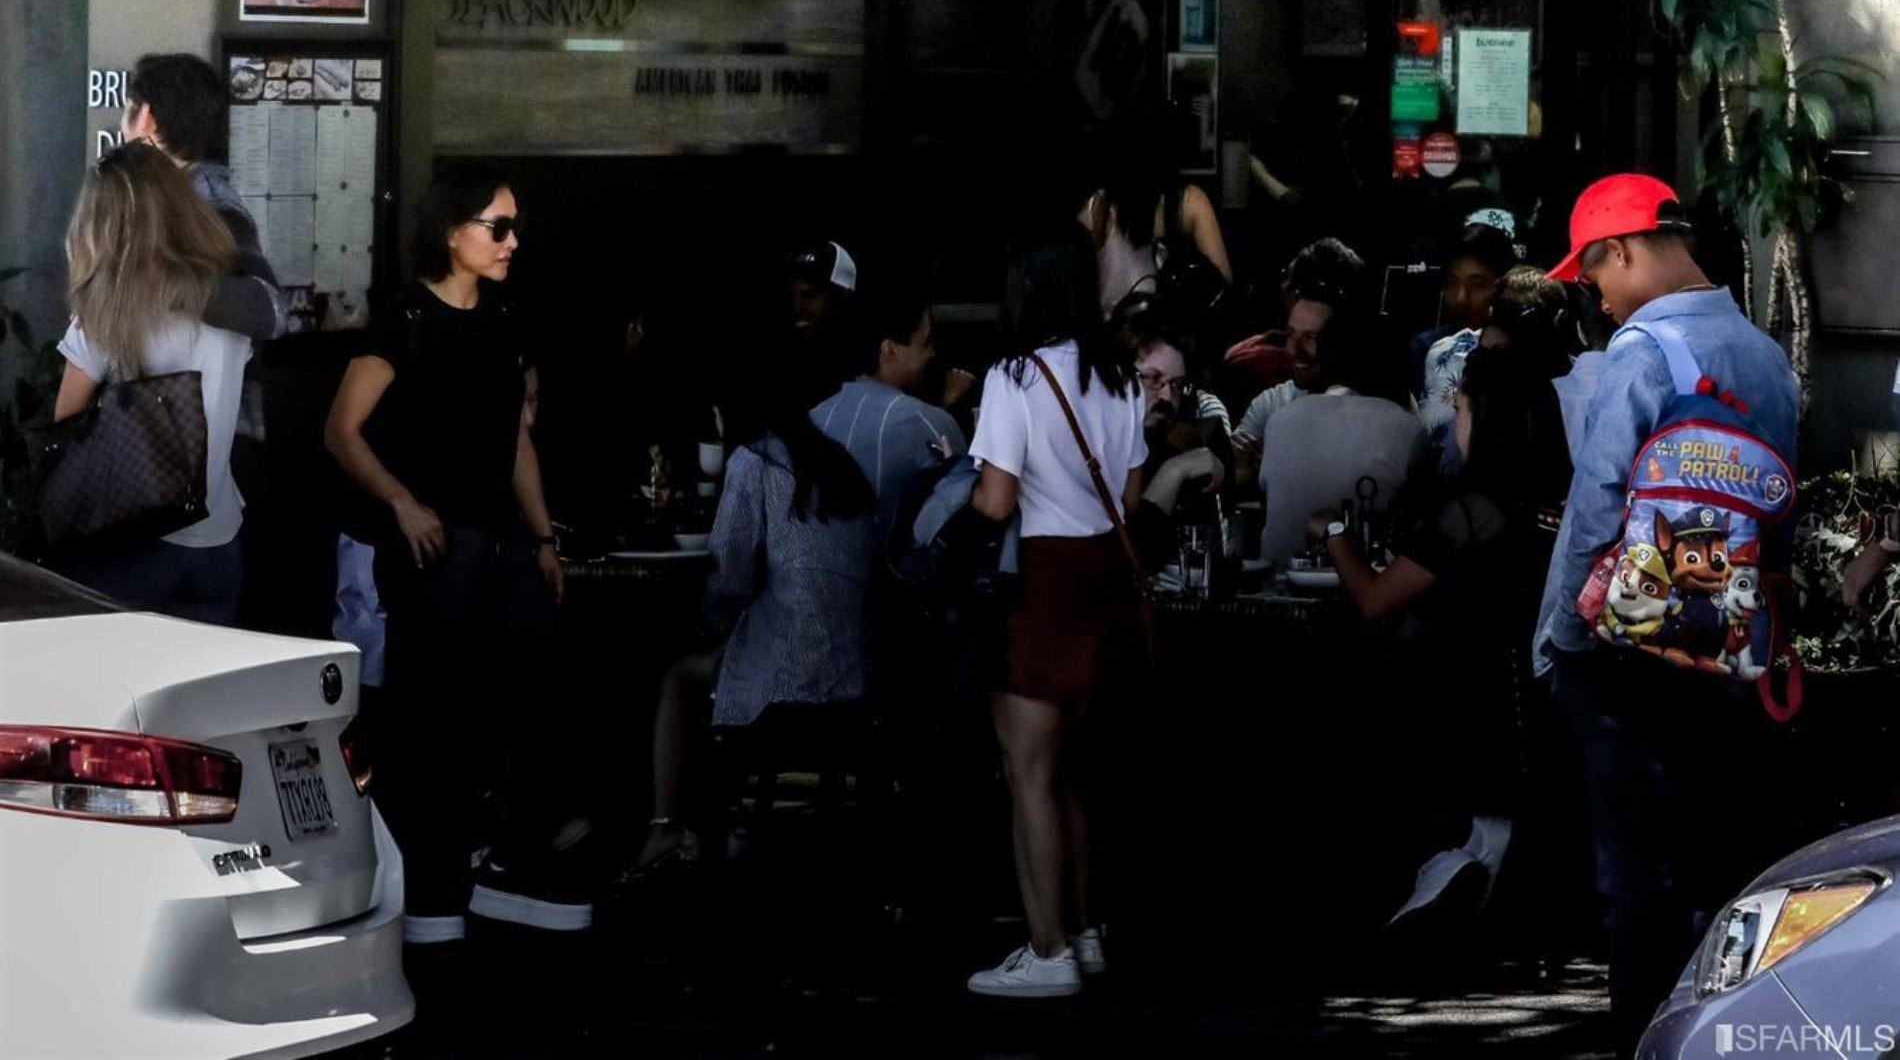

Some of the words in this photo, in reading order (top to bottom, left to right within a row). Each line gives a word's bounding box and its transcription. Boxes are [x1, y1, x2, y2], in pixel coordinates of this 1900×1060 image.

[1654, 441, 1679, 451] CALL
[1679, 441, 1725, 461] PAW
[1656, 450, 1675, 458] THE
